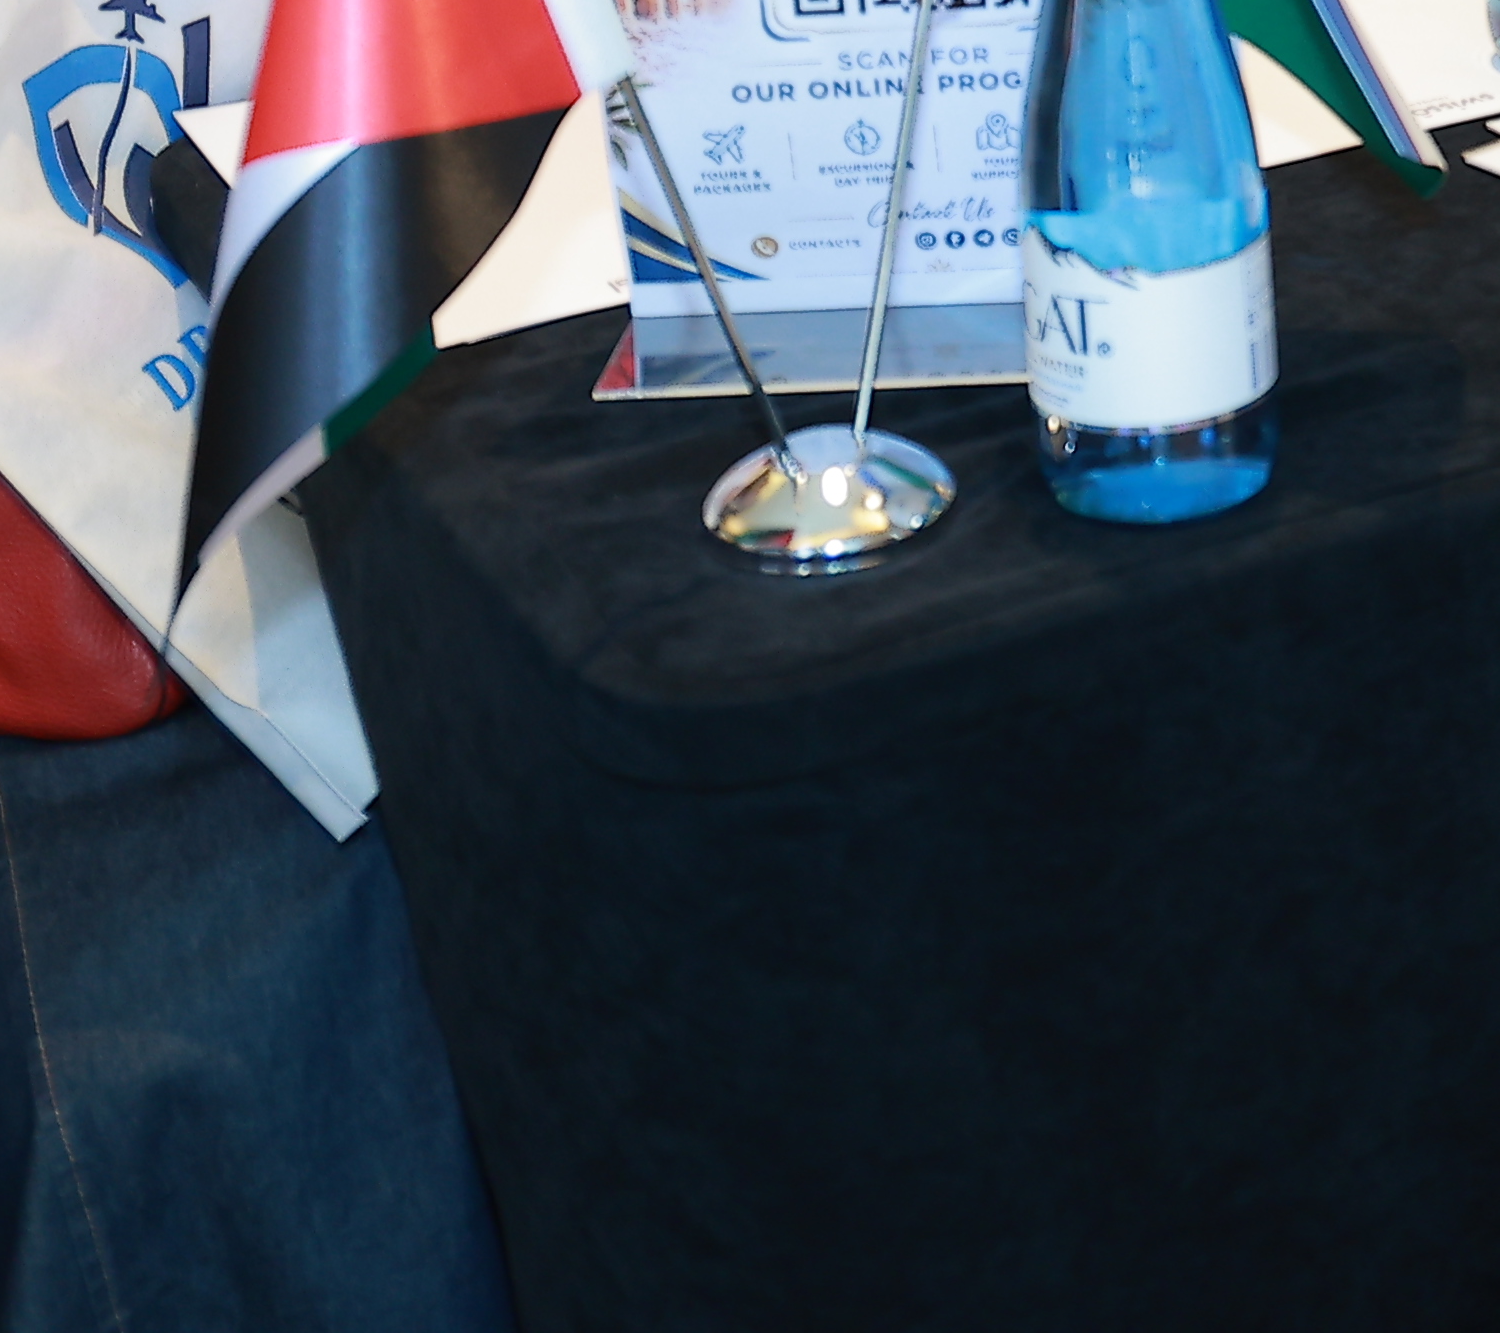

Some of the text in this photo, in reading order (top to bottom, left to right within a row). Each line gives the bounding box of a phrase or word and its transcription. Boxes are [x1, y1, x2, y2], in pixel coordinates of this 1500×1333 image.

[838, 47, 991, 72] SCAN FOR
[731, 83, 797, 104] OUR
[937, 71, 1023, 93] PROG
